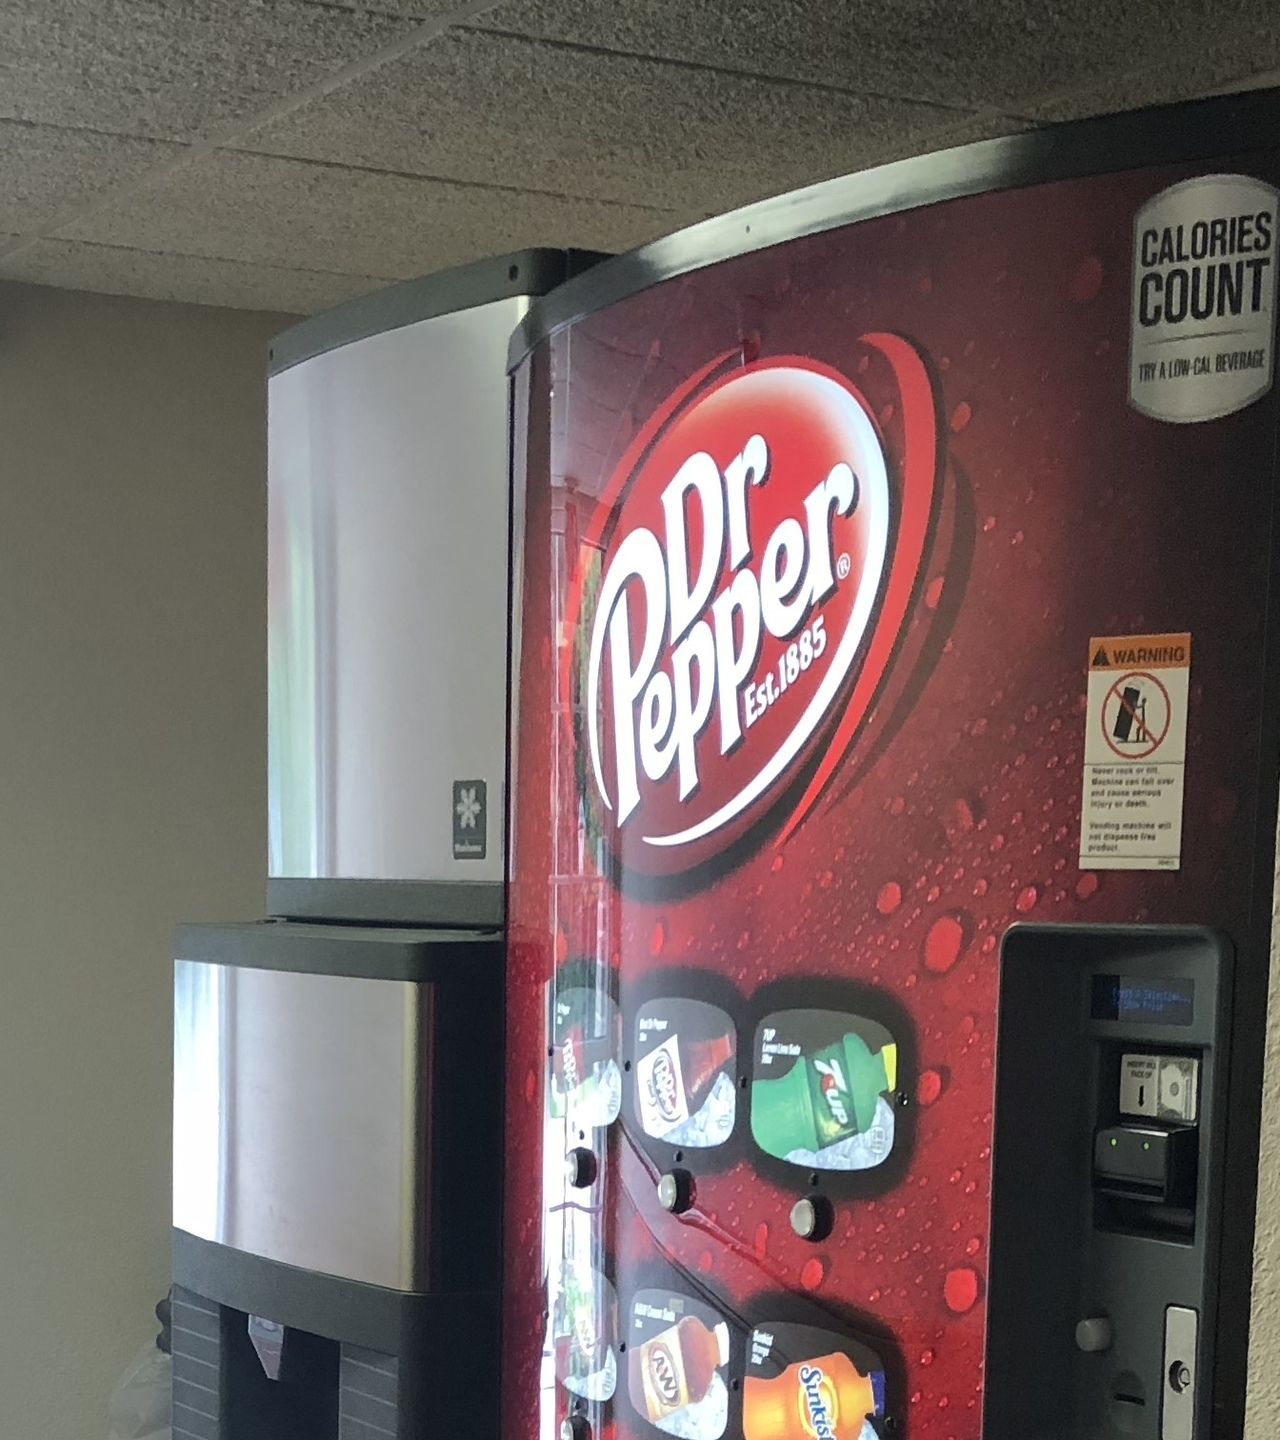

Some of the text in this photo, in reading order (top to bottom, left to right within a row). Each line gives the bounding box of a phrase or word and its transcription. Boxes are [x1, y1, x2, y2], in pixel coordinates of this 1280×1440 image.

[1140, 210, 1272, 268] CALORIES
[1139, 256, 1271, 328] COUNT
[1138, 363, 1156, 383] TRY
[1158, 361, 1167, 380] A
[1215, 348, 1266, 374] BEVERAGE
[661, 434, 768, 645] Dr
[589, 462, 856, 828] Pepper
[1112, 646, 1185, 665] WARNING
